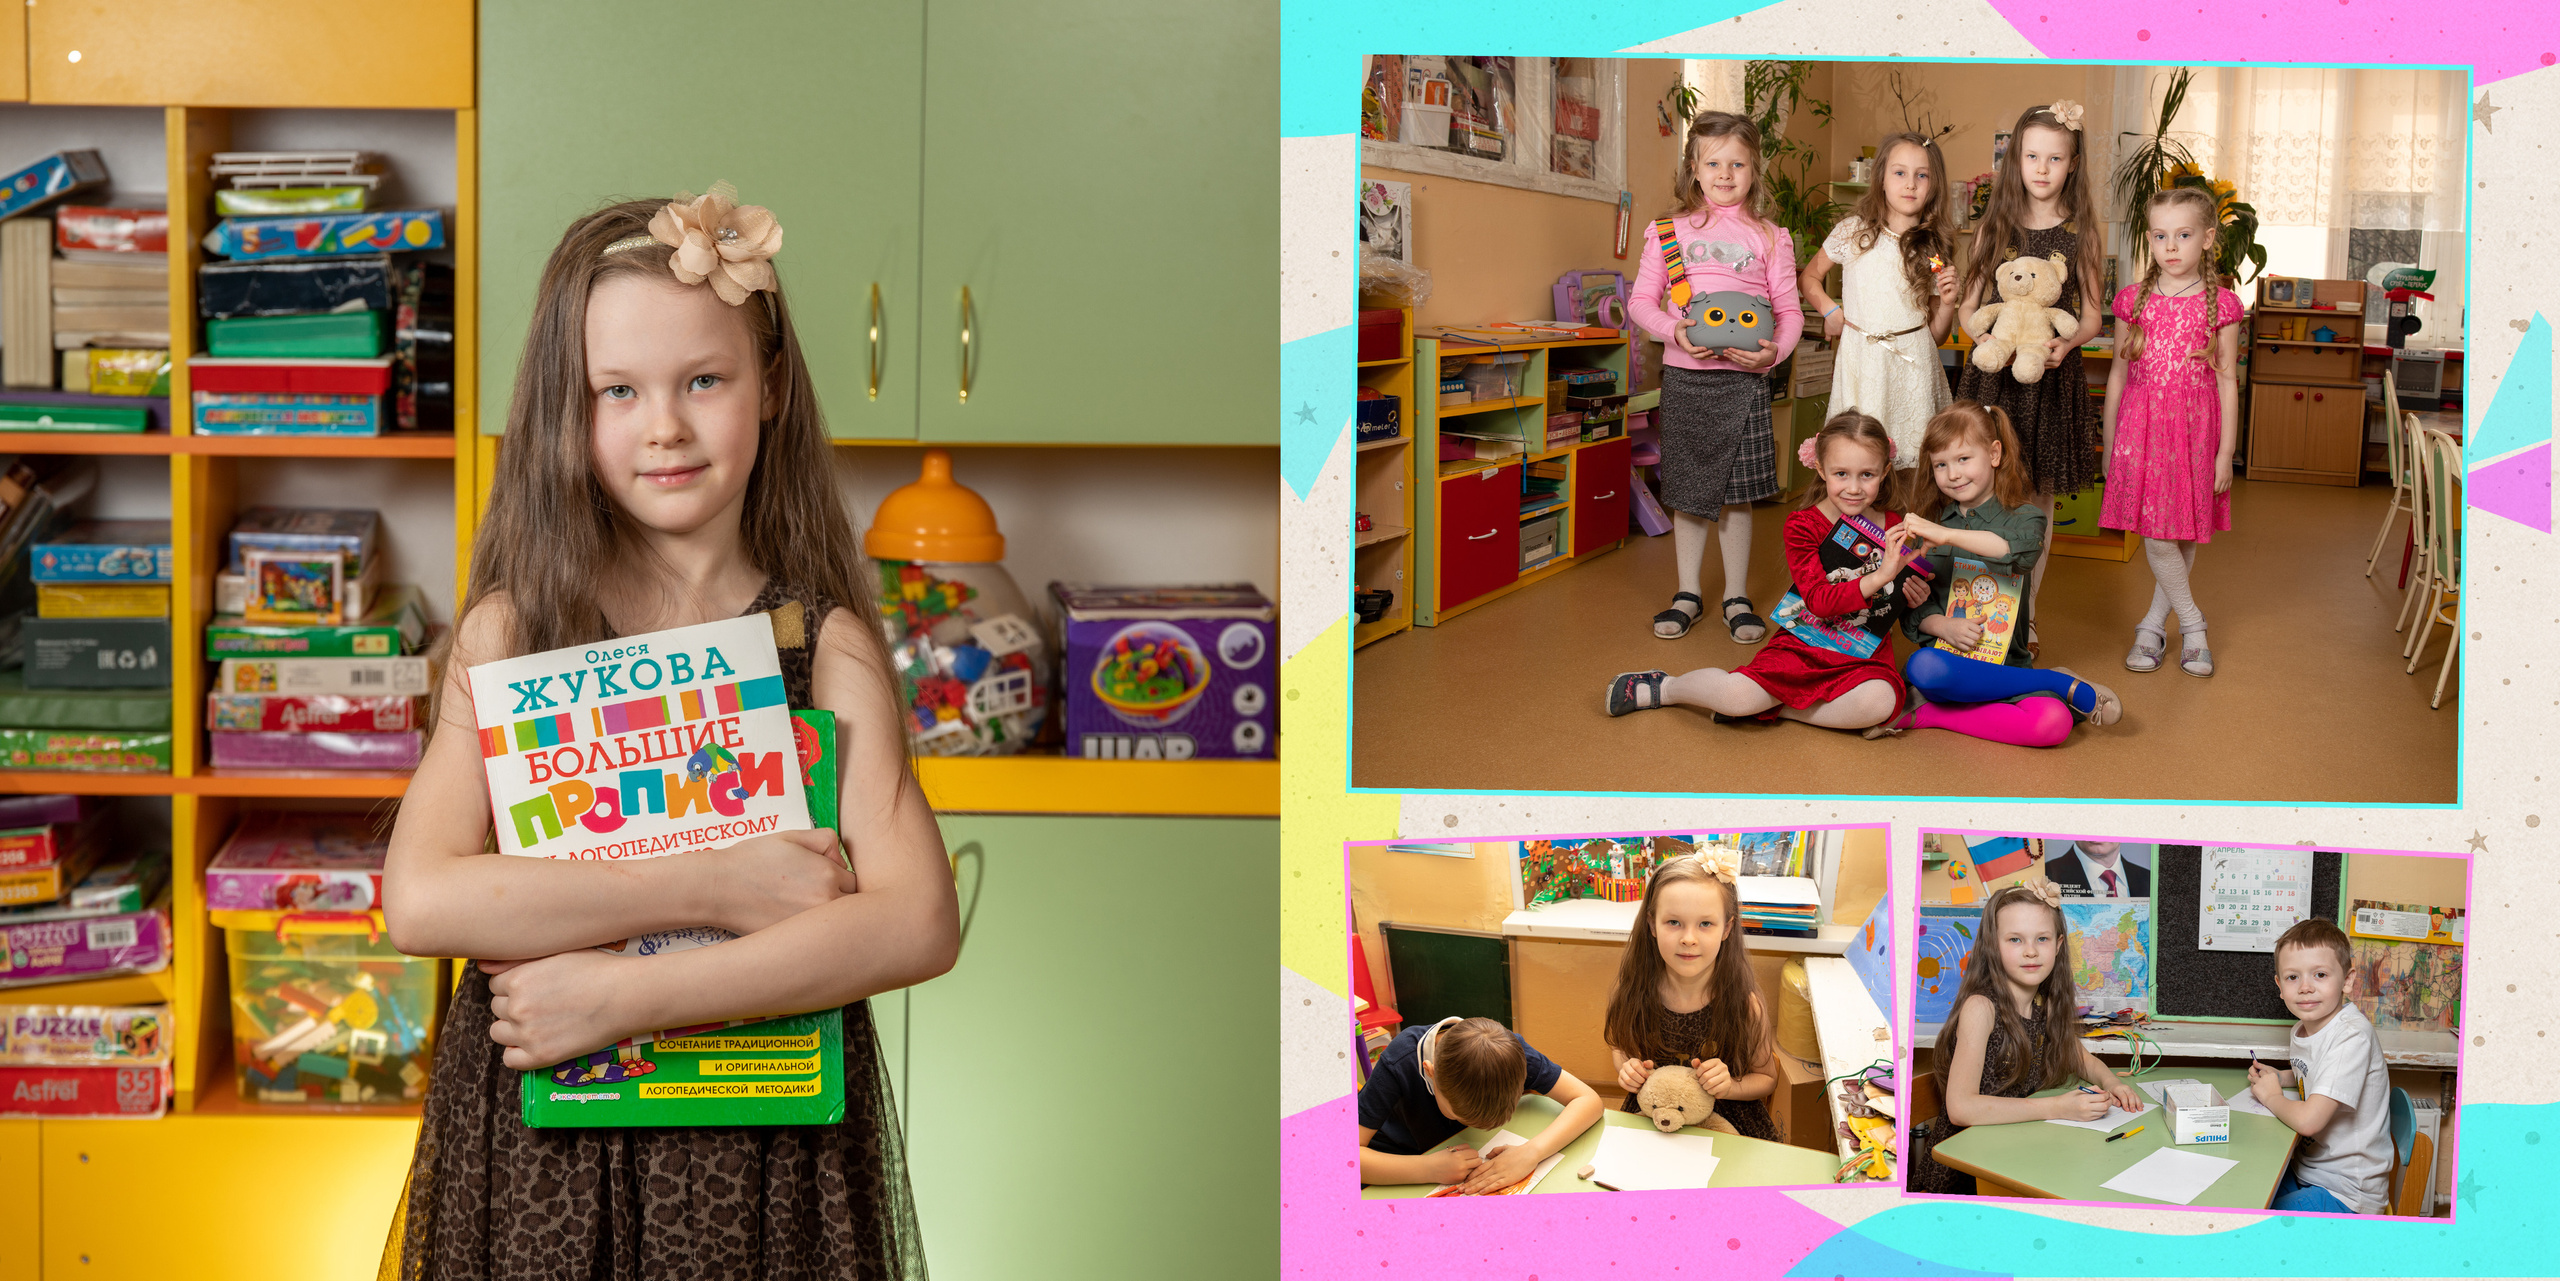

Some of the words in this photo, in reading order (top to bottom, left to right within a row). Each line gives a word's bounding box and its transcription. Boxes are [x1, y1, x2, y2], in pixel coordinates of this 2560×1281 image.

[1954, 561, 1977, 572] СТИХИ
[1798, 608, 1853, 651] космоса
[585, 643, 650, 664] Олеся
[1971, 646, 2003, 657] ЗЫВАЮТ
[508, 646, 736, 714] ЖУКОВА
[525, 716, 745, 784] БОЛЬШИЕ
[509, 751, 786, 849] ПРОПИСИ
[569, 814, 780, 860] ЛОГОПЕДИЧЕСКОМУ
[2217, 846, 2246, 854] АПРЕЛЬ
[9, 922, 79, 948] PUZZLE
[15, 1017, 101, 1037] PUZZLE
[659, 1039, 721, 1050] СОЧЕТАНИЕ
[724, 1037, 814, 1050] ТРАДИЦИОННОЙ
[715, 1063, 723, 1072] И
[726, 1060, 814, 1072] ОРИГИНАЛЬНОЙ
[120, 1071, 151, 1093] 35
[646, 1084, 749, 1096] ЛОГОПЕДИЧЕСКОЙ
[755, 1085, 815, 1095] МЕТОДИКИ
